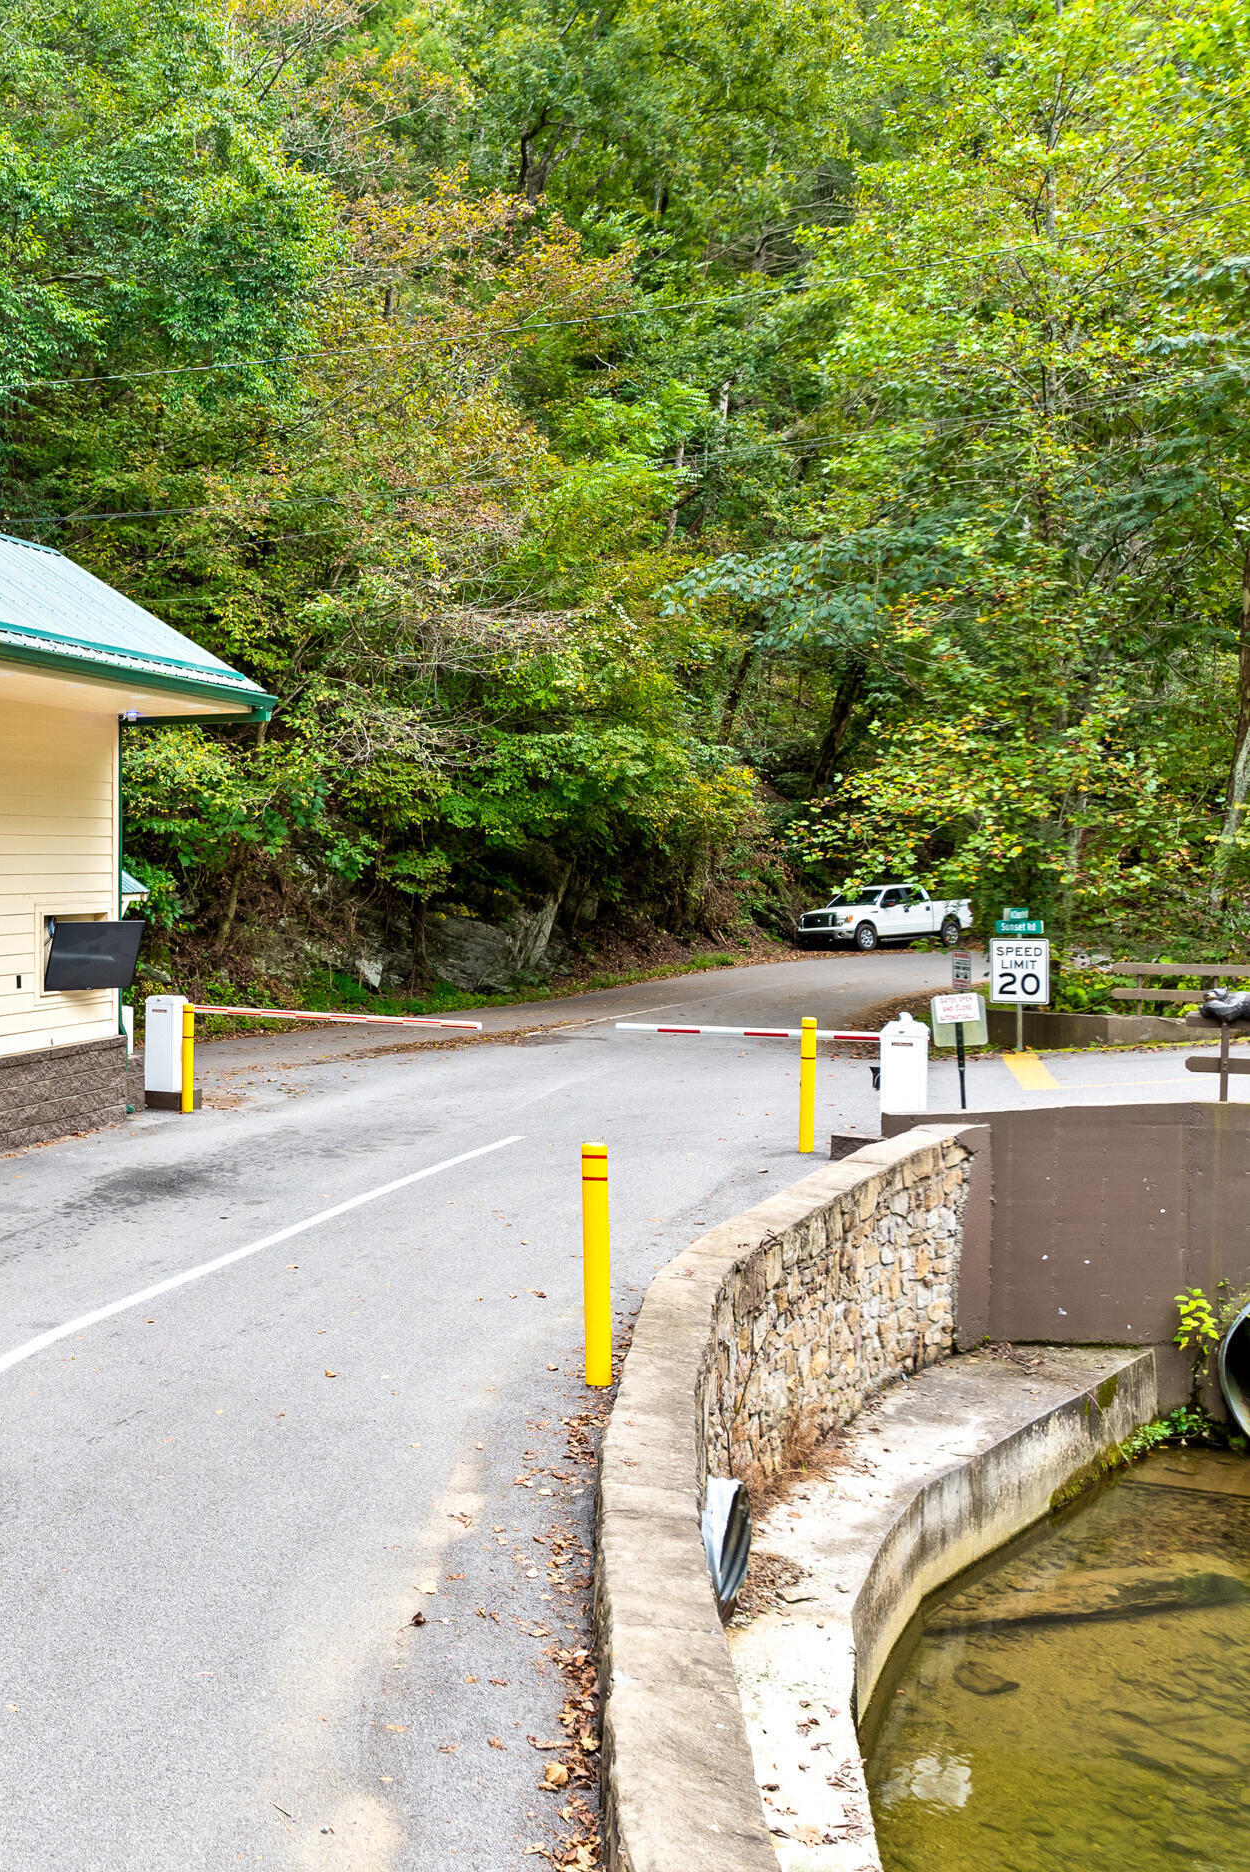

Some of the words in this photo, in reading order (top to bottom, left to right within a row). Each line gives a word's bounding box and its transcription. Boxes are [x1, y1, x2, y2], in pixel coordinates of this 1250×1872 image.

[1000, 922, 1026, 931] Sunset
[1027, 922, 1037, 931] Rd
[996, 946, 1043, 957] SPEED
[1001, 960, 1037, 970] LIMIT
[998, 972, 1041, 996] 20
